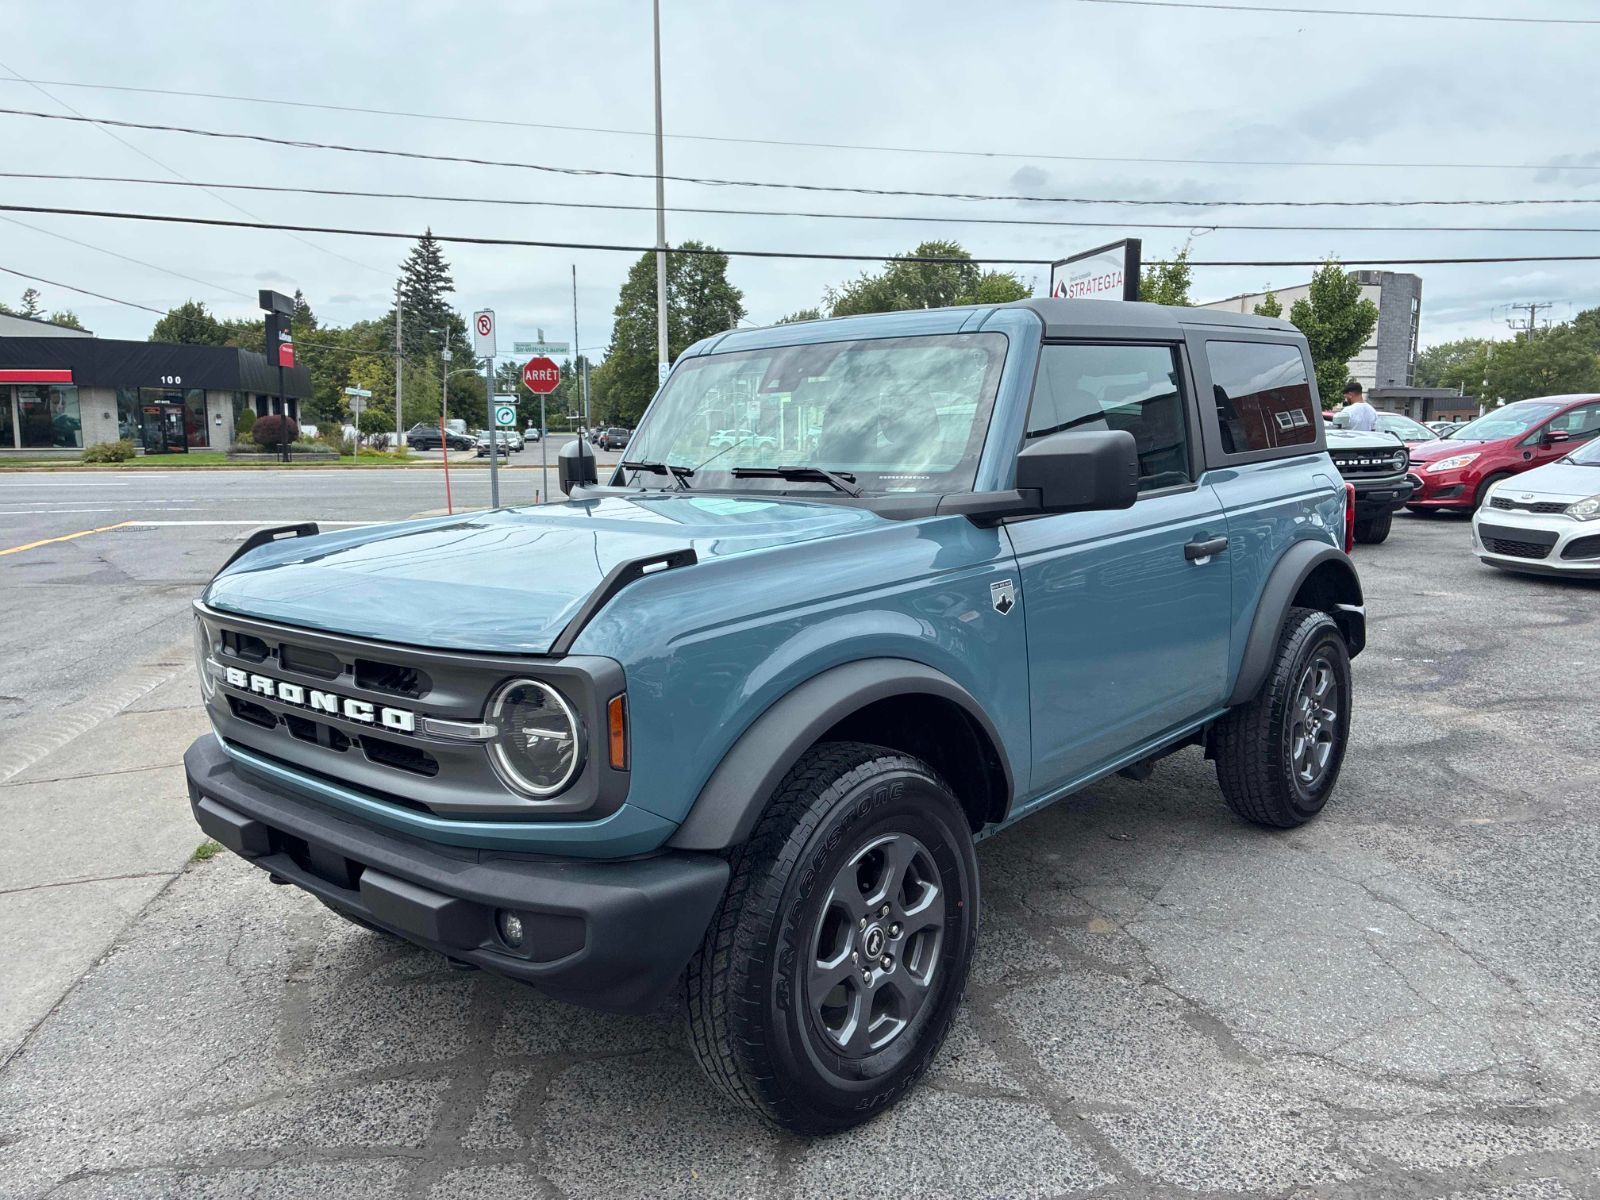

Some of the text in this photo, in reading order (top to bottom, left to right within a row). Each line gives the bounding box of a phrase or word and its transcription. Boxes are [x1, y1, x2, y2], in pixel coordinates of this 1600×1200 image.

[1069, 272, 1123, 298] STRATEGIA
[161, 376, 181, 384] 100
[525, 368, 558, 381] ARRÊT
[226, 666, 415, 732] BRONCO
[775, 782, 904, 1011] BRIDGESTONE
